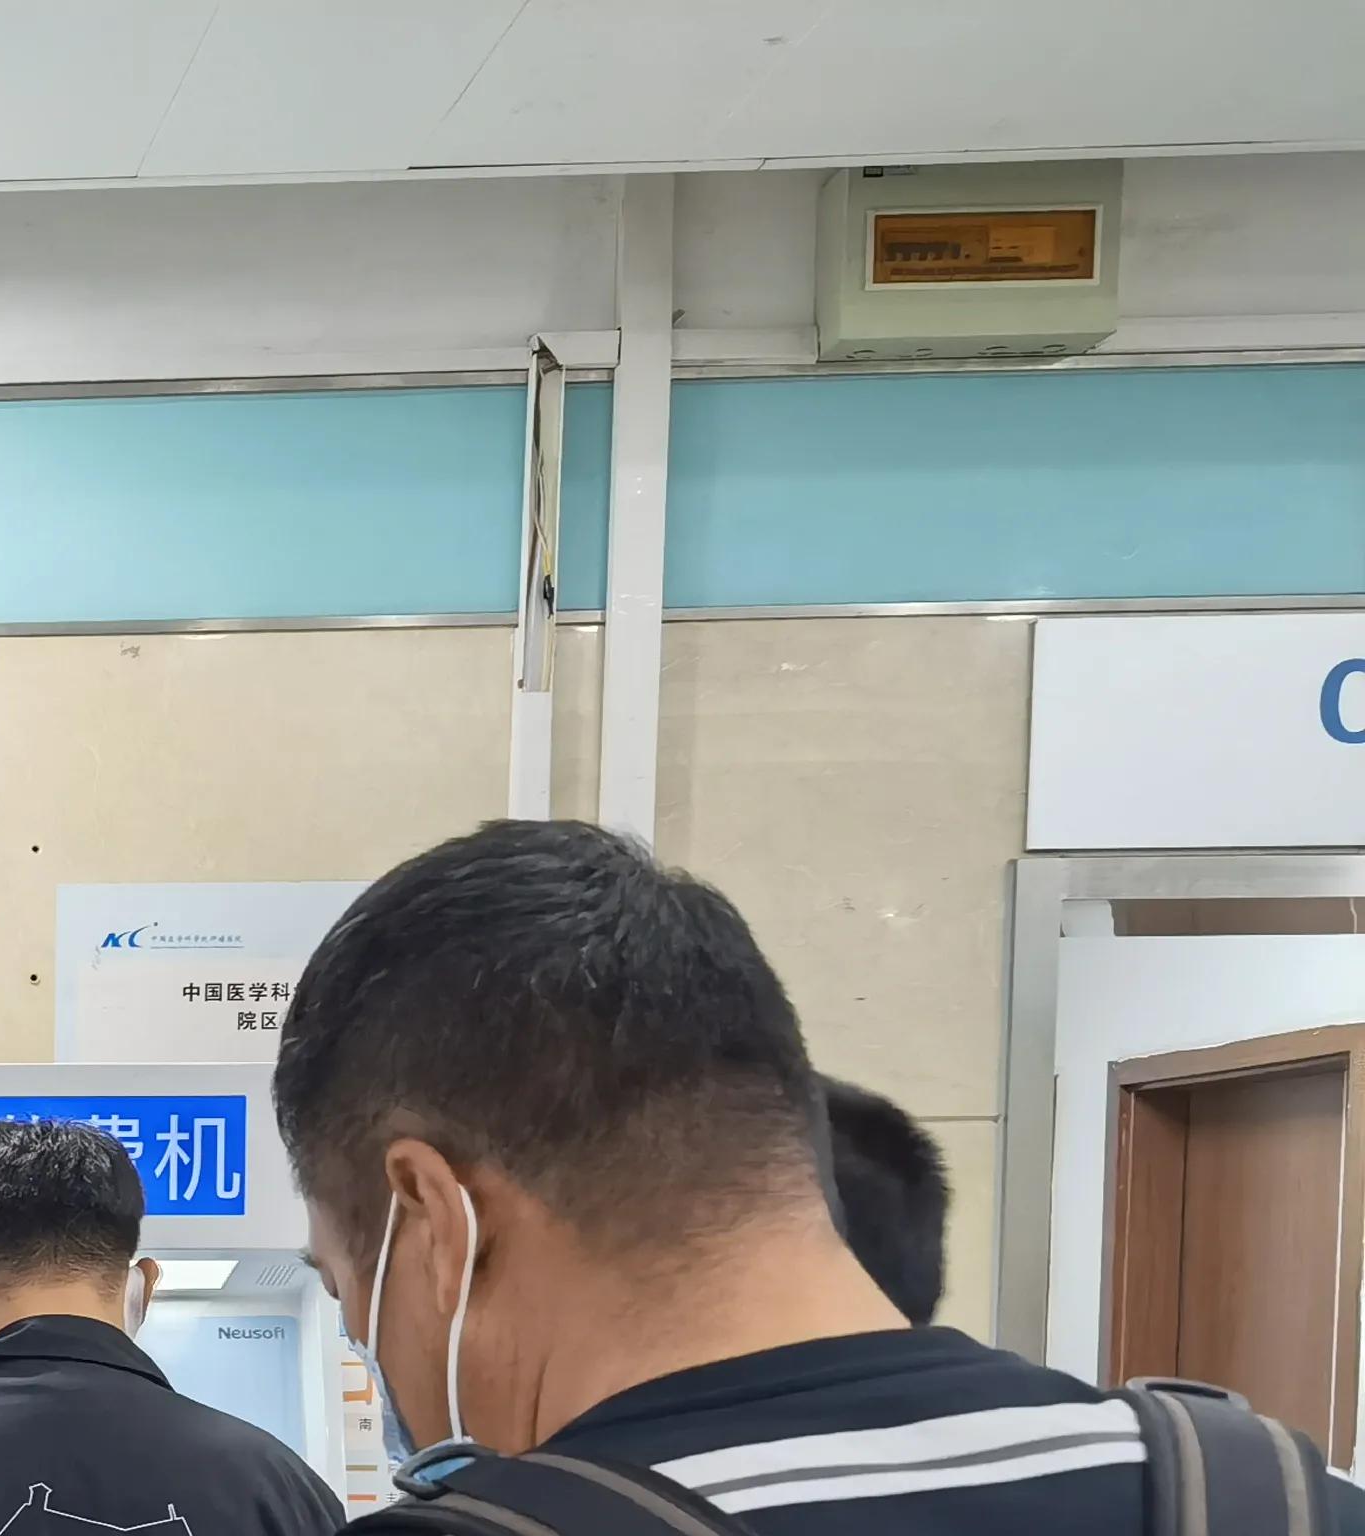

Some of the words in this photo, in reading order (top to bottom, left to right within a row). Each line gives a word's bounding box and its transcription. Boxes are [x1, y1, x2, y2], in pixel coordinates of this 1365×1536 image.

[181, 981, 297, 1002] 中国医学科
[237, 1011, 279, 1031] 院区
